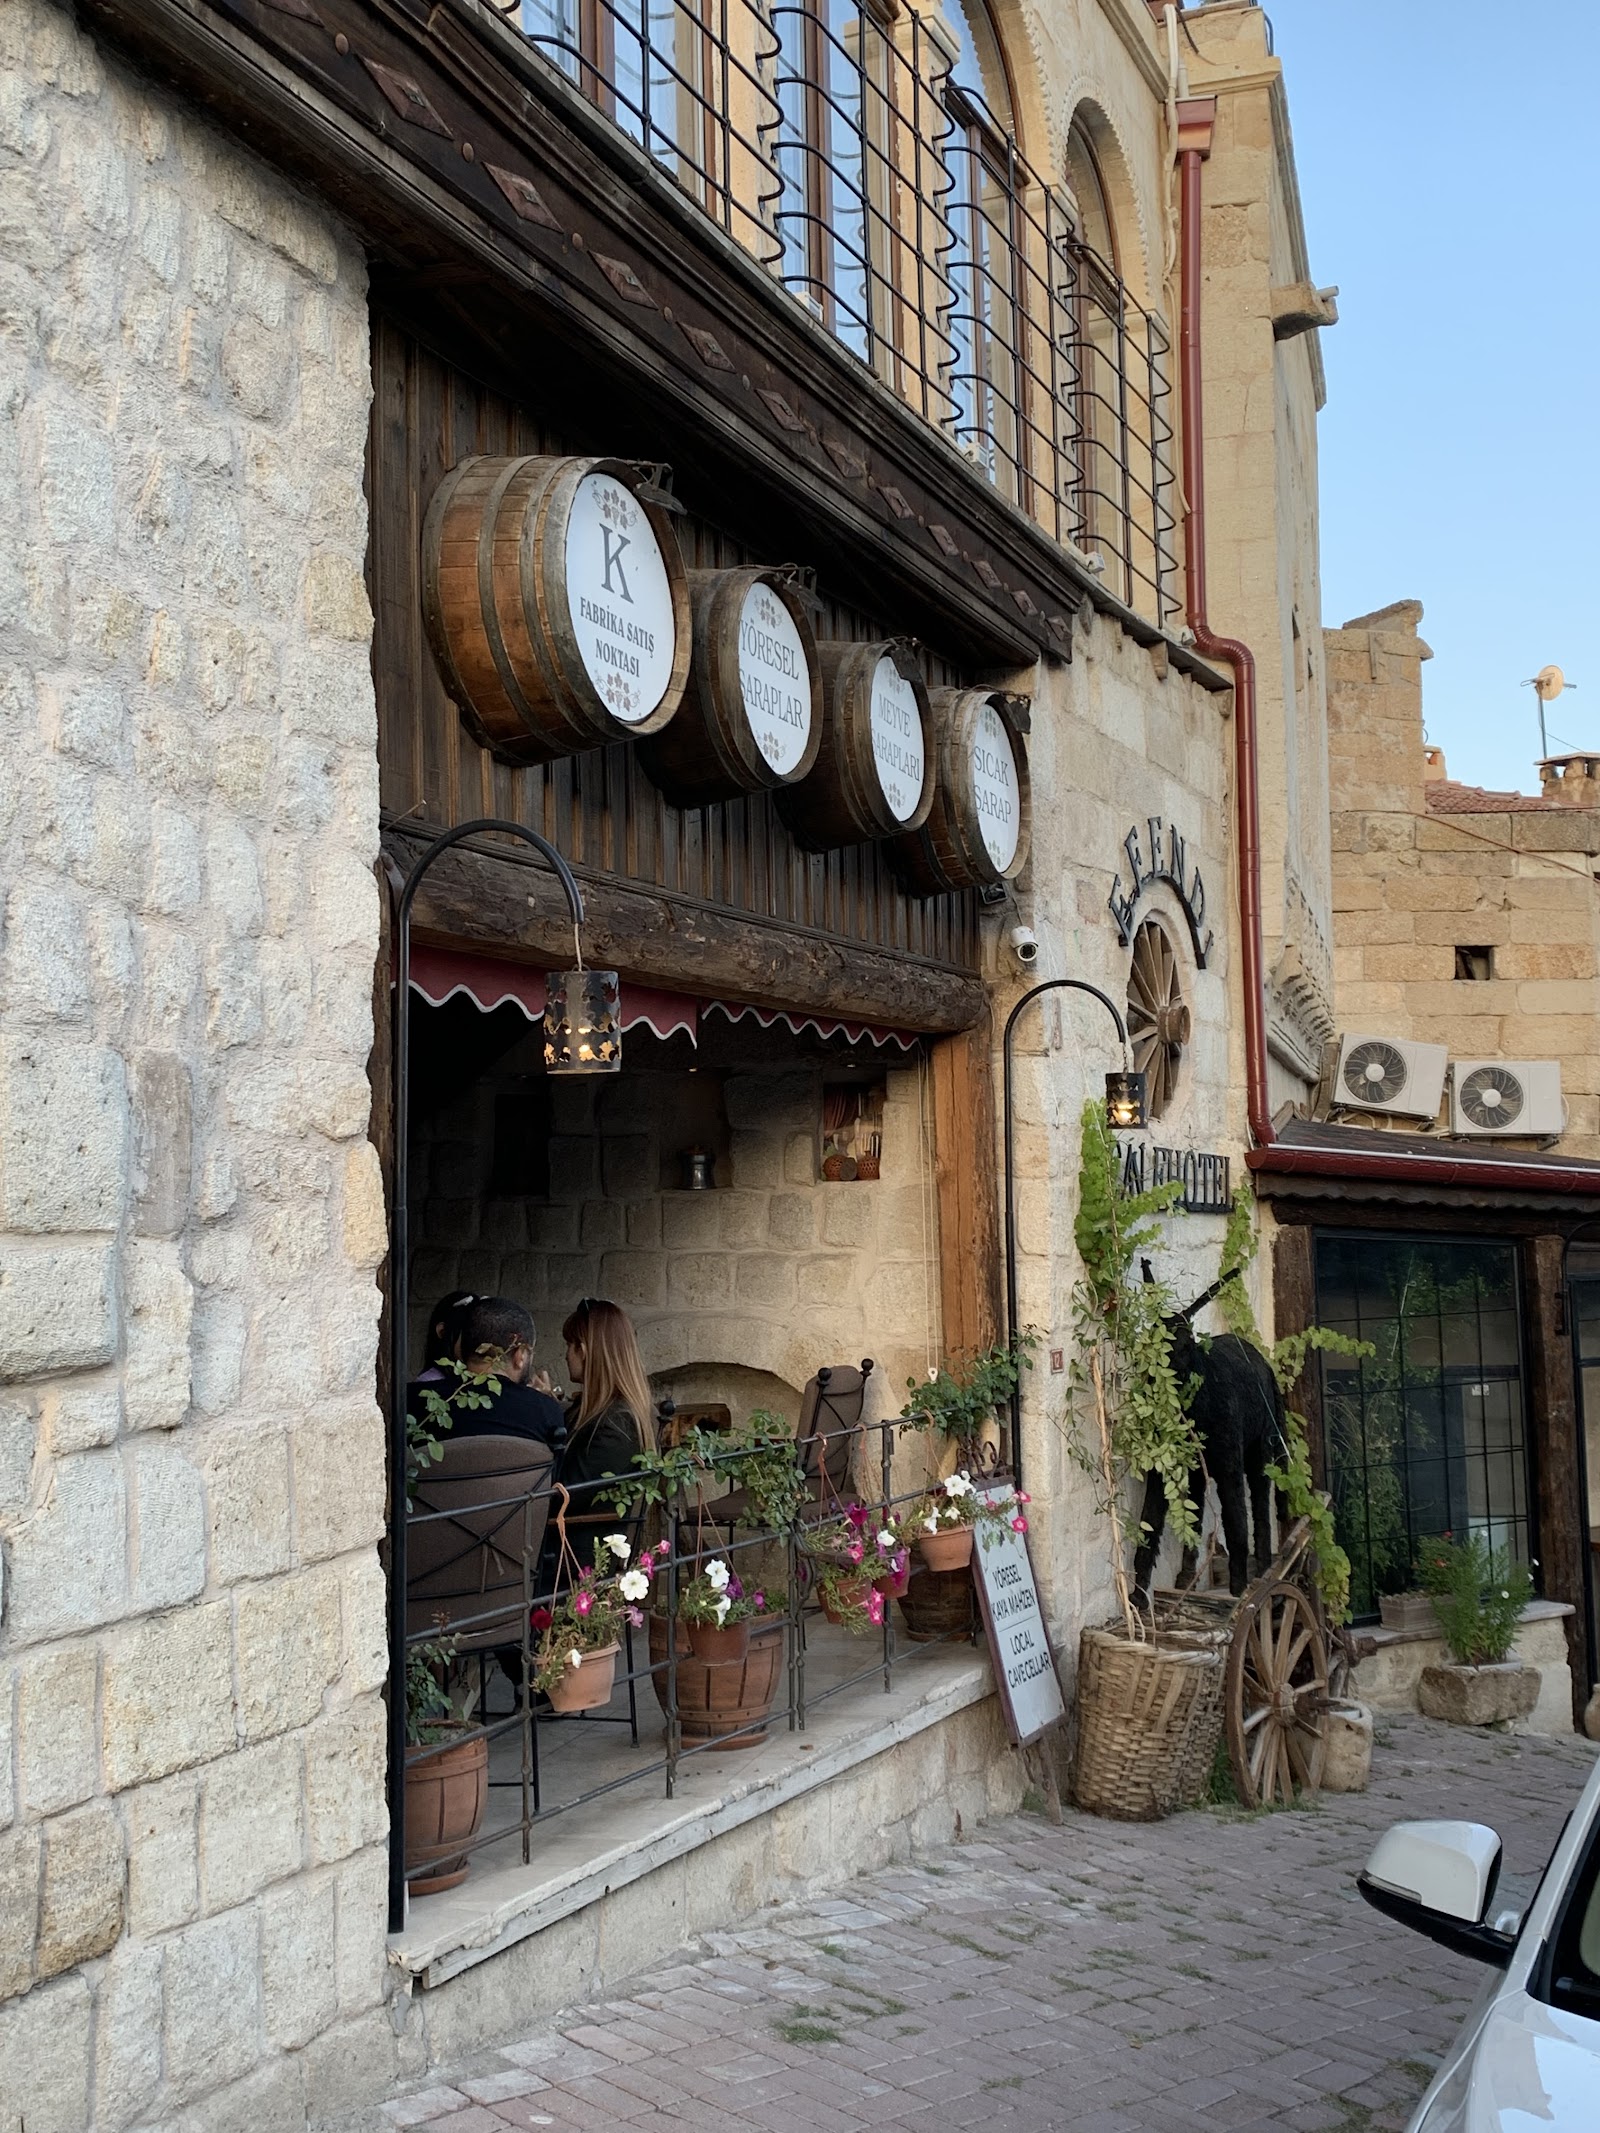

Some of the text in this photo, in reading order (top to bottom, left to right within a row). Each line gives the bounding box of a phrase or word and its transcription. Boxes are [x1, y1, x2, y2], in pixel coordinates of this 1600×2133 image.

[598, 522, 634, 604] K
[580, 596, 655, 659] FABRİKA SATIŞ
[595, 638, 640, 678] NOKTASI
[740, 617, 800, 681] YÖRESEL
[878, 692, 911, 738] MEYVE
[973, 745, 1010, 787] SICAK
[992, 1563, 1022, 1590] YÖRESEL
[991, 1587, 1036, 1623] KAYA MAHZEN
[1009, 1630, 1034, 1655] LOCAL
